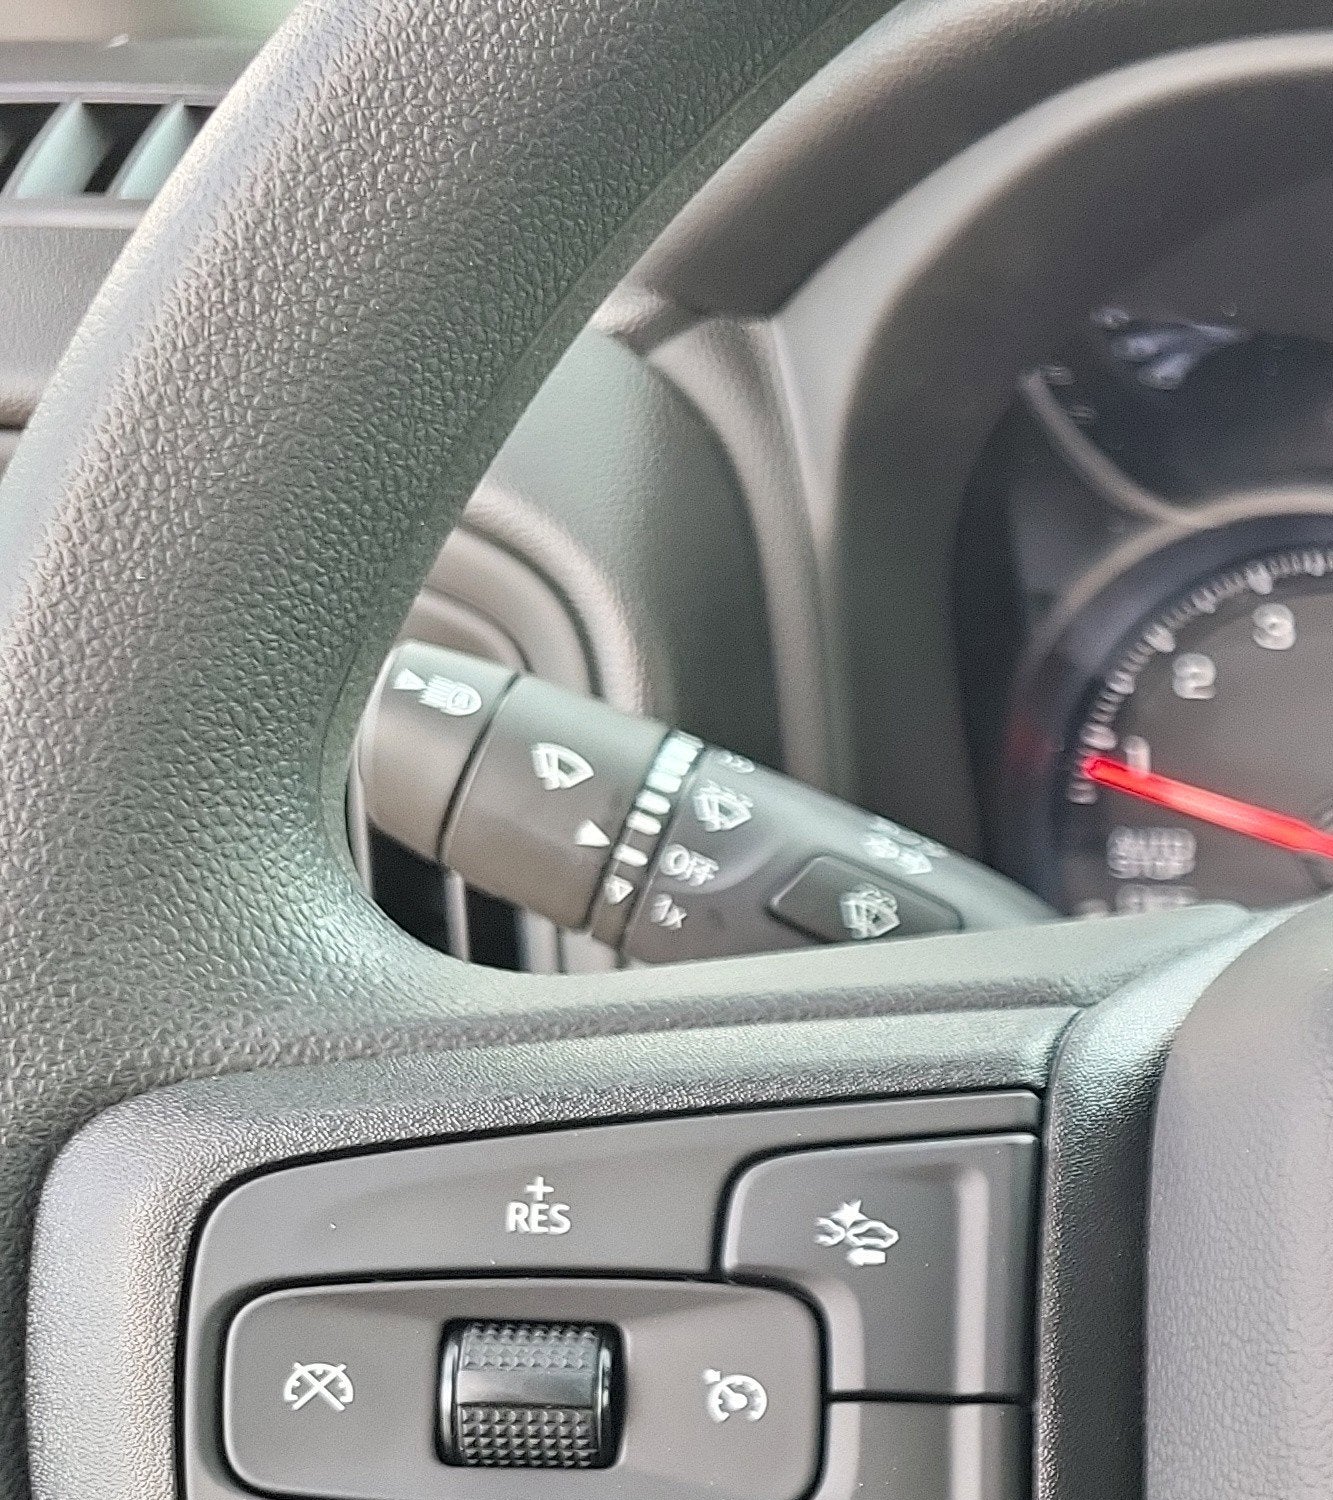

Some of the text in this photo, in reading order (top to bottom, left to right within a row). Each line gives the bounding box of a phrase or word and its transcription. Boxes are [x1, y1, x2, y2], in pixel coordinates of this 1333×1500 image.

[1252, 603, 1296, 650] 3
[1172, 652, 1217, 700] 2
[660, 844, 719, 887] OFF
[506, 1201, 571, 1234] RES
